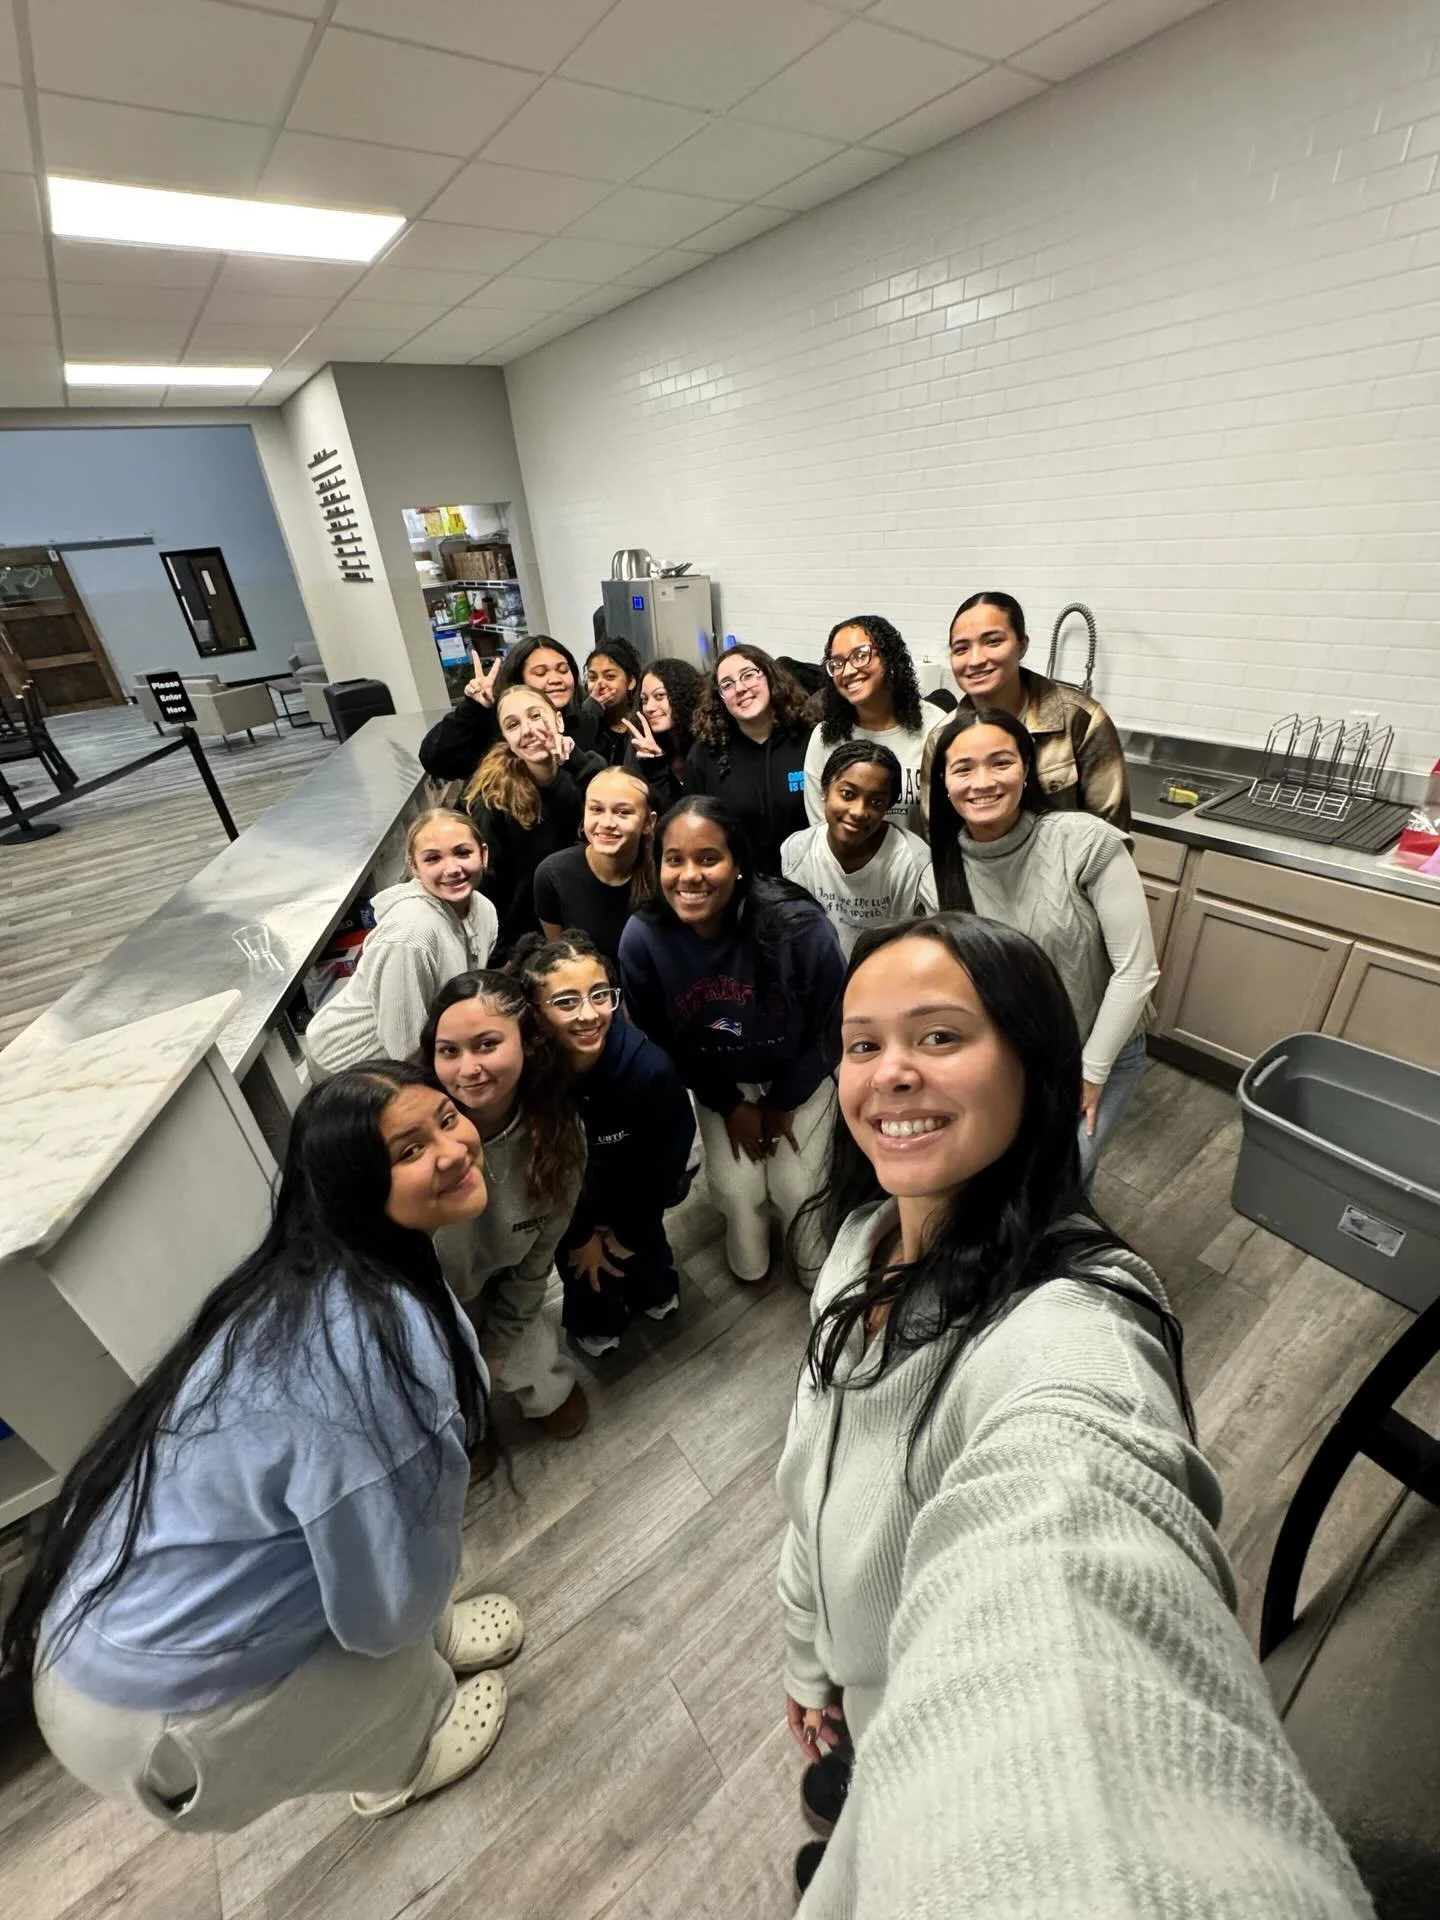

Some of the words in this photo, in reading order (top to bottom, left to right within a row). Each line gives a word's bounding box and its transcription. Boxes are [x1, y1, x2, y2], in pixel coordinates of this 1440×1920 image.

[151, 681, 179, 690] Please
[159, 694, 182, 702] Enter
[166, 706, 187, 714] Here
